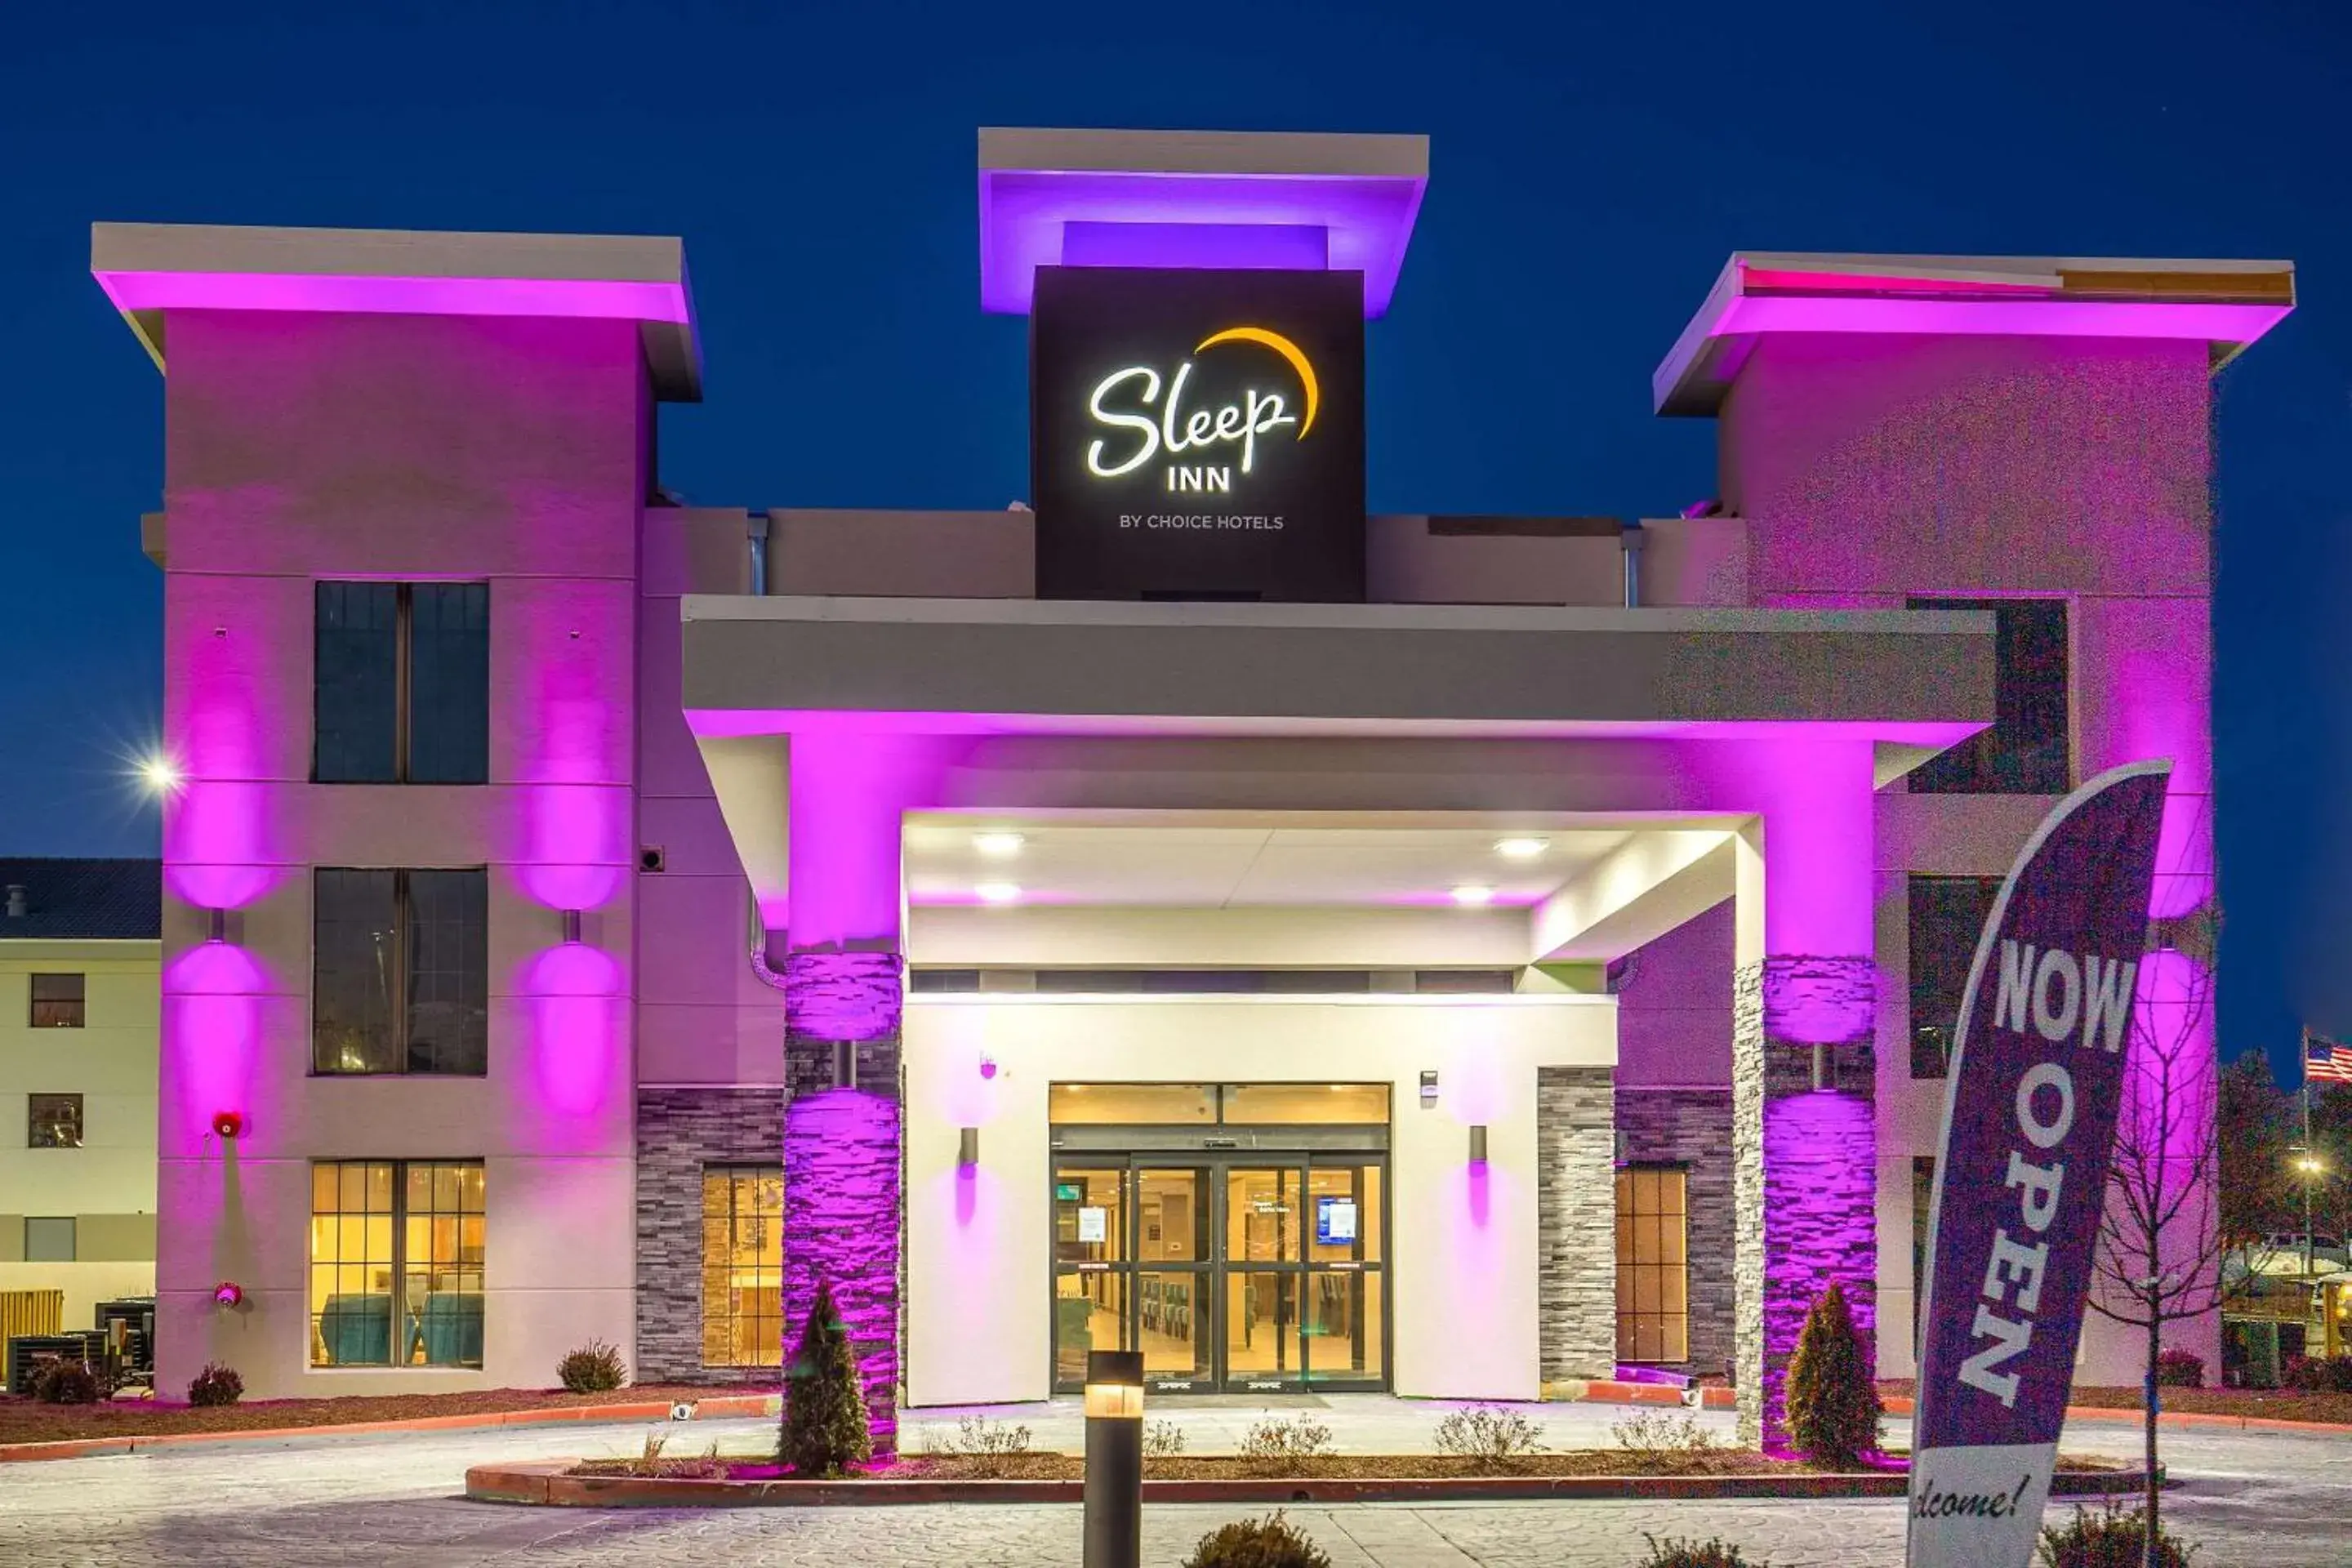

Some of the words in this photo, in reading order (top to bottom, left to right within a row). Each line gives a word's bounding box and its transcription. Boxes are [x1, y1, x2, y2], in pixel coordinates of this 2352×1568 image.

[1087, 362, 1295, 478] Sleep
[1120, 515, 1142, 528] BY
[1147, 515, 1213, 529] CHOICE
[1218, 516, 1284, 530] HOTELS
[1168, 466, 1231, 492] INN
[1993, 938, 2137, 1054] NOW
[1958, 1062, 2074, 1409] OPEN
